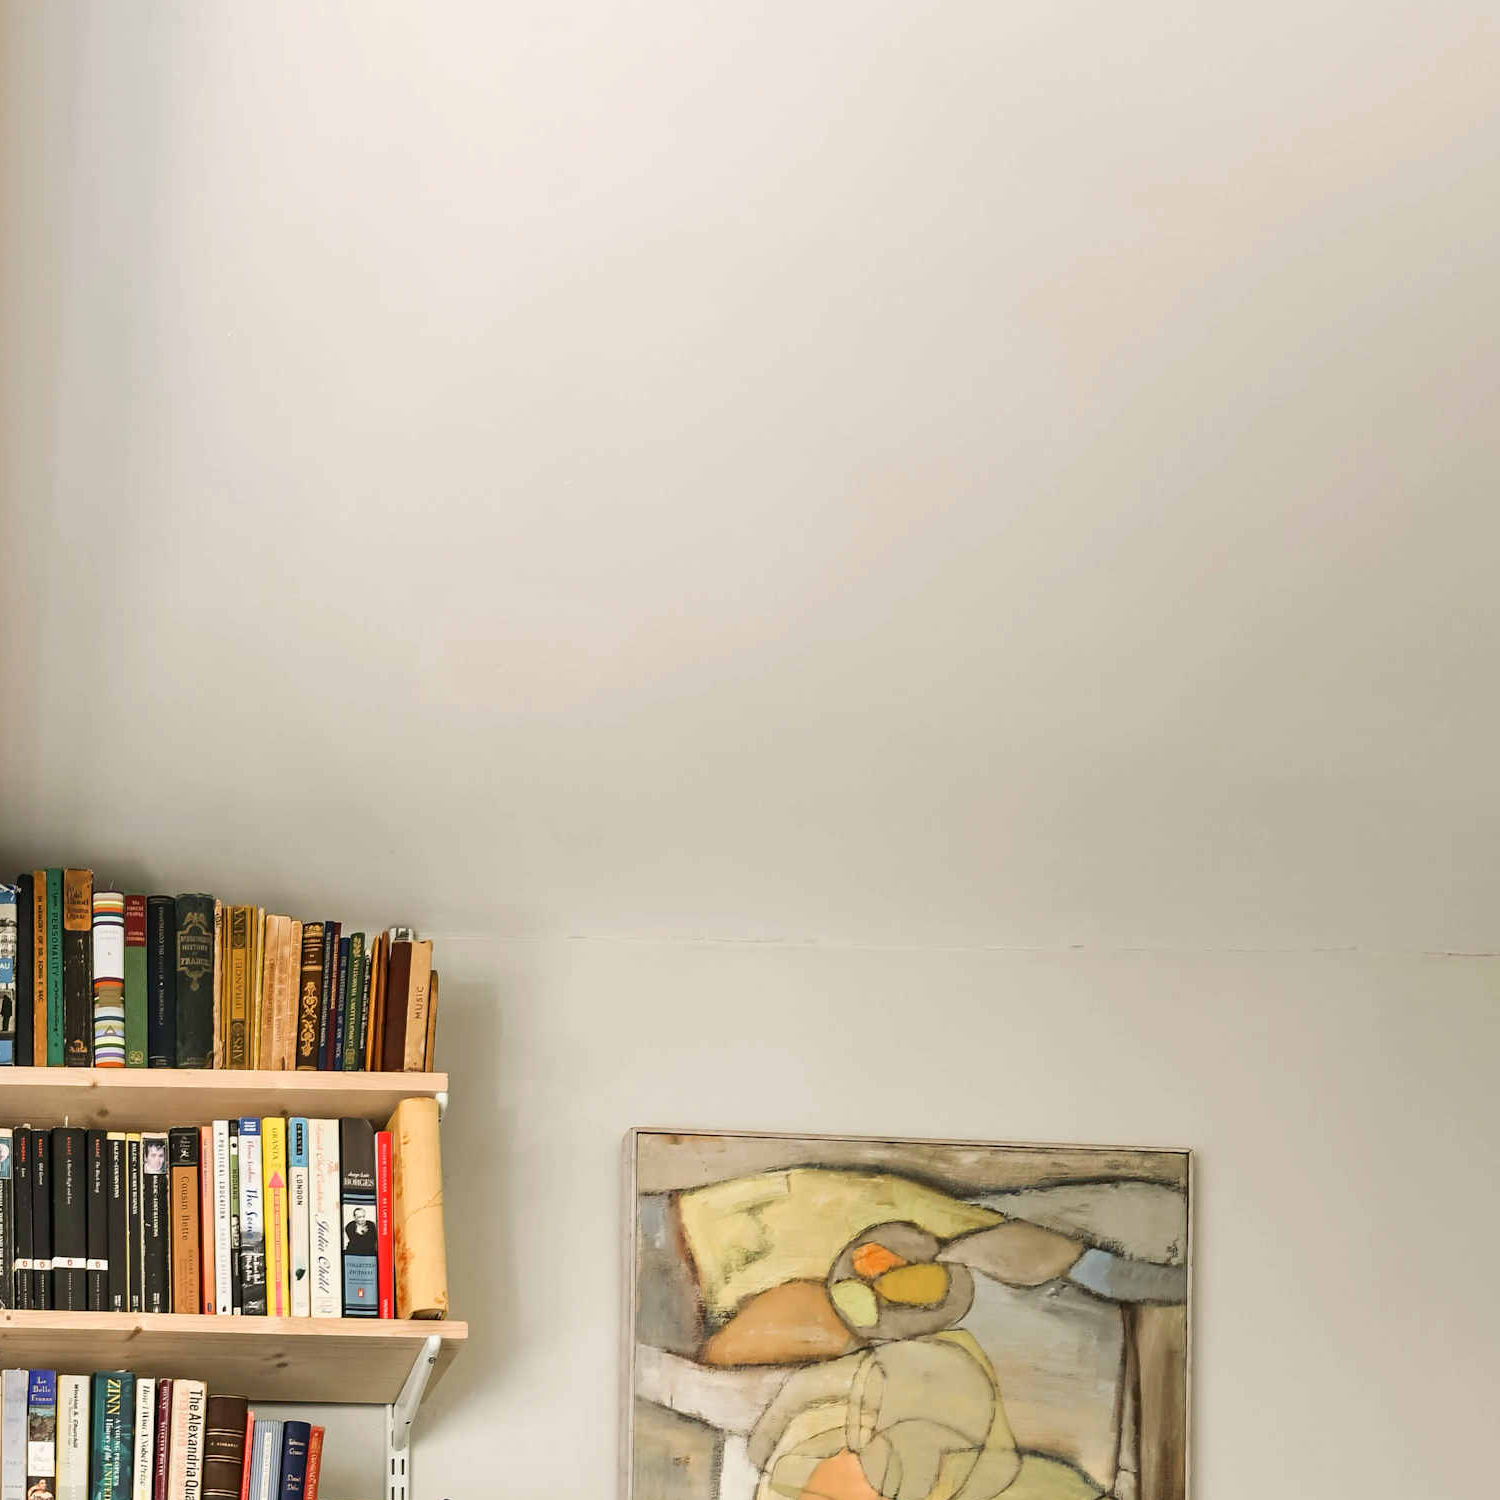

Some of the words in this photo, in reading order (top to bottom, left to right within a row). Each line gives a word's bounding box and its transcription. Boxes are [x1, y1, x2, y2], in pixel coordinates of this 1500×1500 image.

[51, 912, 59, 976] PERSONALITY
[415, 987, 424, 1019] MUSIC
[315, 1215, 330, 1252] Julia
[318, 1256, 331, 1293] Child
[107, 1378, 121, 1415] ZINN
[190, 1390, 203, 1411] The
[186, 1413, 202, 1477] Alexandria
[104, 1463, 113, 1500] UNITED
